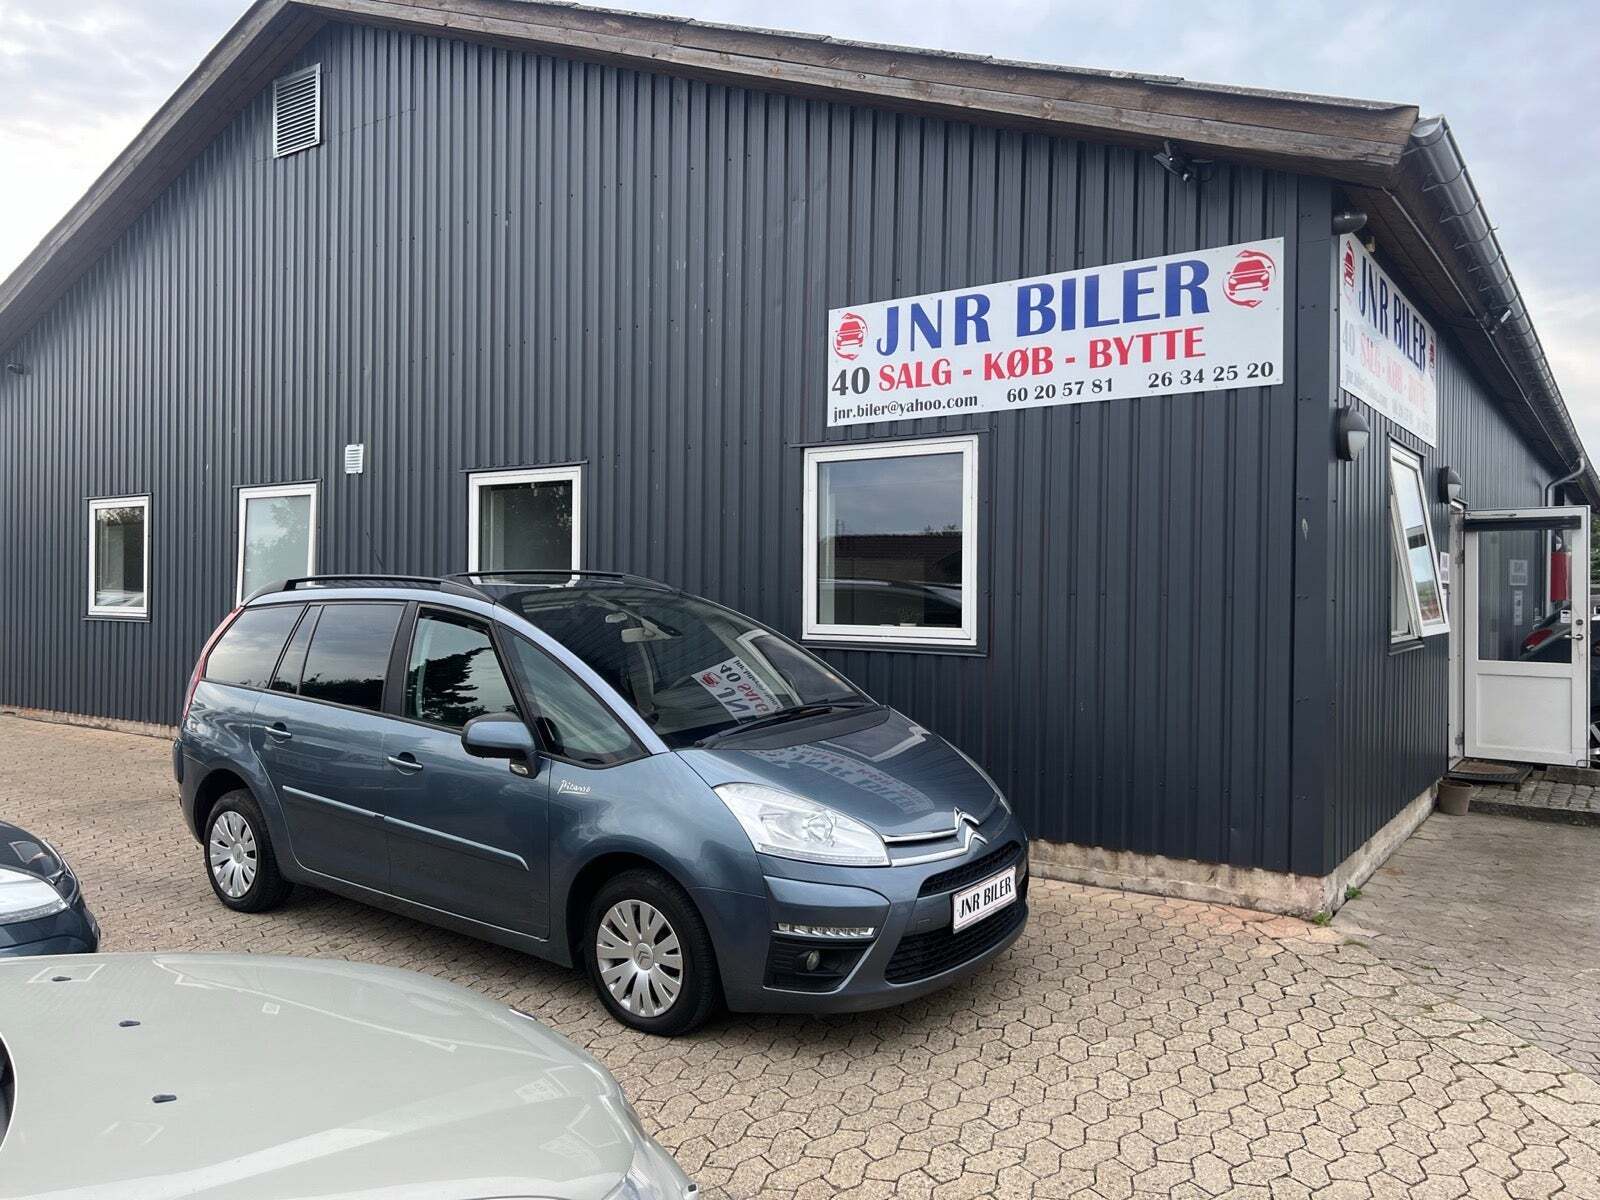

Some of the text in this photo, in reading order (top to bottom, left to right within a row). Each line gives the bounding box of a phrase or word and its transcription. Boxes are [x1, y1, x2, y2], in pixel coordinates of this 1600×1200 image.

[876, 259, 1210, 356] JNR BILER
[1359, 255, 1427, 373] JNR BILER
[1342, 320, 1356, 356] 40
[831, 366, 871, 396] 40
[878, 358, 951, 391] SALG
[984, 346, 1054, 380] KØB
[1089, 326, 1207, 369] BYTTE
[1149, 361, 1274, 388] 26 34 25 20
[833, 394, 978, 423] jnr.biler@yahoo.com
[1007, 378, 1113, 402] 60 20 57 81
[959, 876, 1012, 918] JNR BILER
